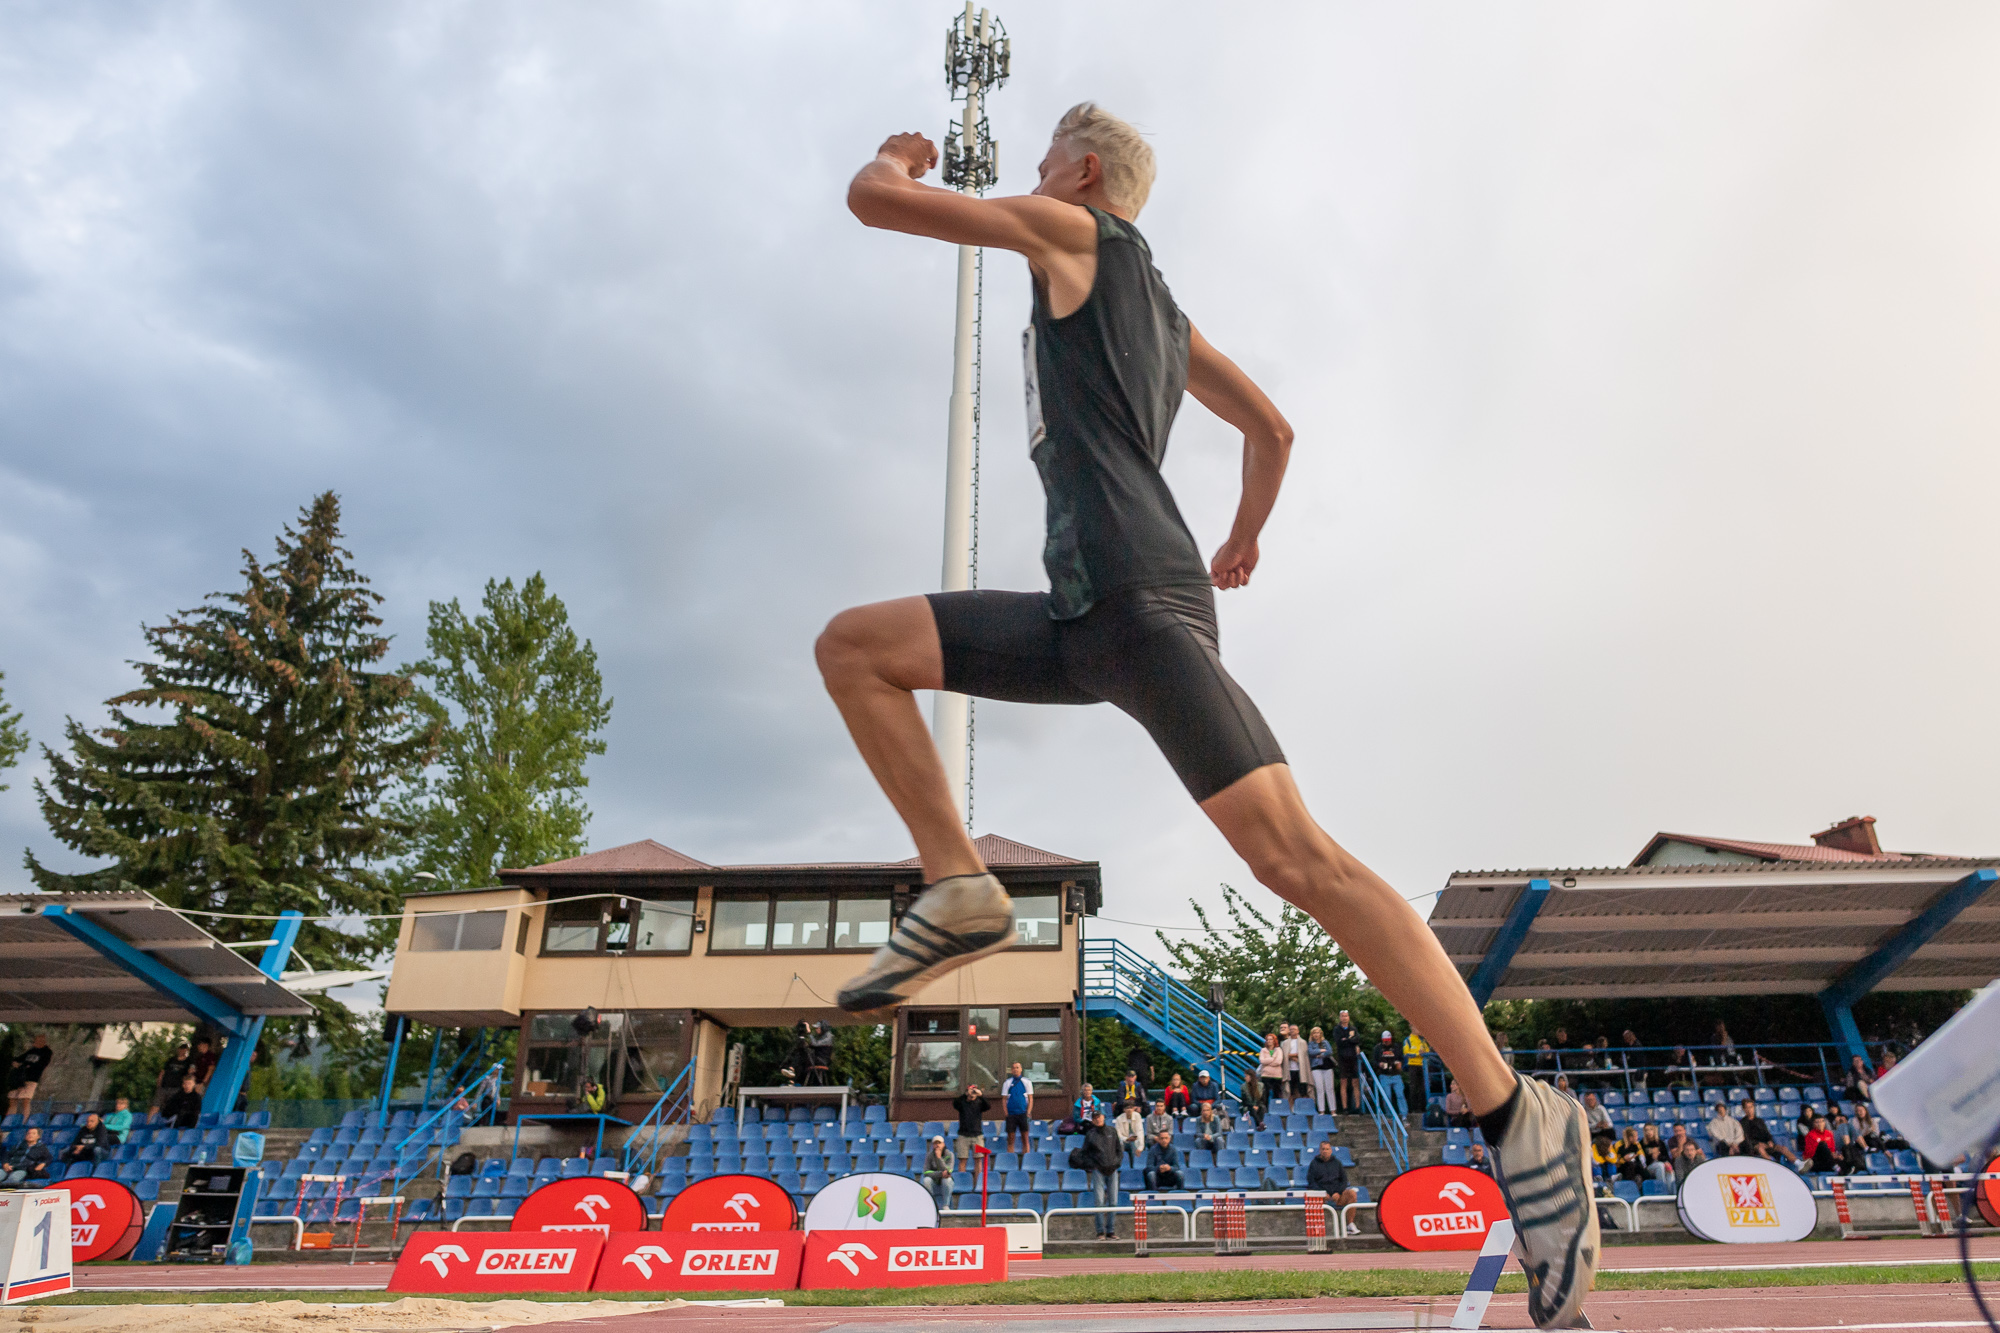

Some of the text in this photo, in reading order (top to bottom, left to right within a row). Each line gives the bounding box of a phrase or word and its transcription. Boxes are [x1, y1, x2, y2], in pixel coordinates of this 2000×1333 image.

[1419, 1214, 1480, 1233] ORLEN
[1730, 1209, 1776, 1224] PZLA
[33, 1210, 52, 1270] 1
[485, 1252, 569, 1271] ORLEN
[688, 1253, 772, 1272] ORLEN
[894, 1248, 977, 1268] ORLEN
